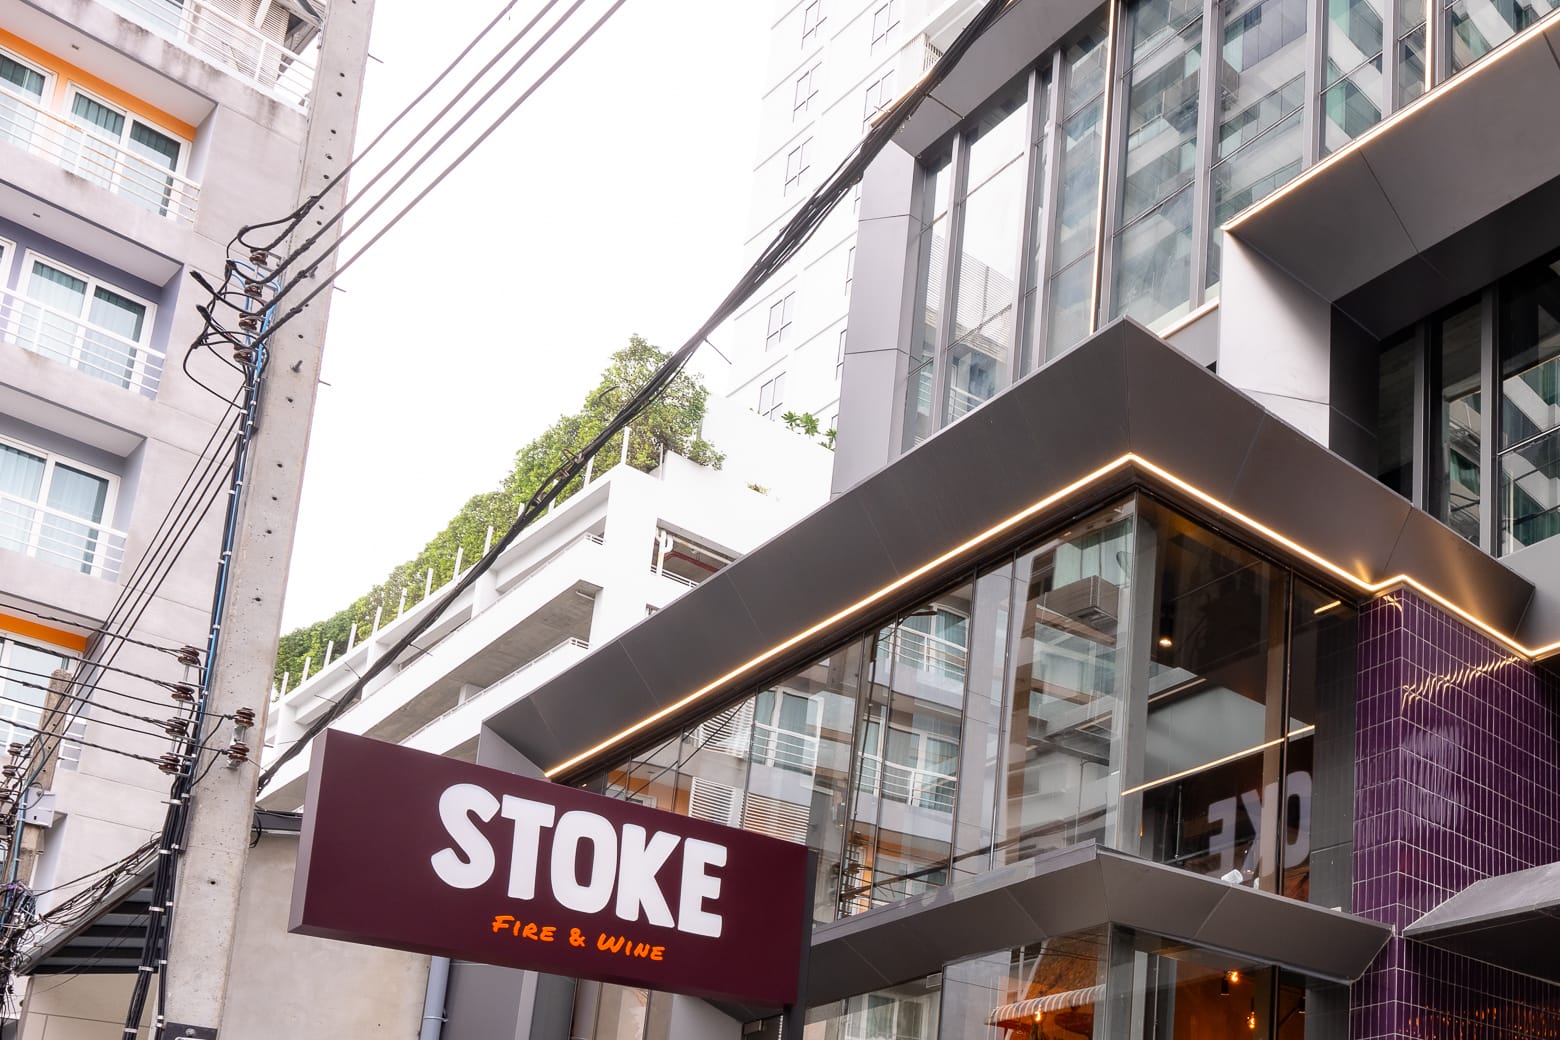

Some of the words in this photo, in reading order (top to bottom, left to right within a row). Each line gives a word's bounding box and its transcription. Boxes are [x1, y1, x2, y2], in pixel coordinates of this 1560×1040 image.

[430, 783, 728, 938] STOKE
[491, 915, 557, 942] FIRE
[569, 928, 586, 948] &
[597, 933, 666, 961] WINE
